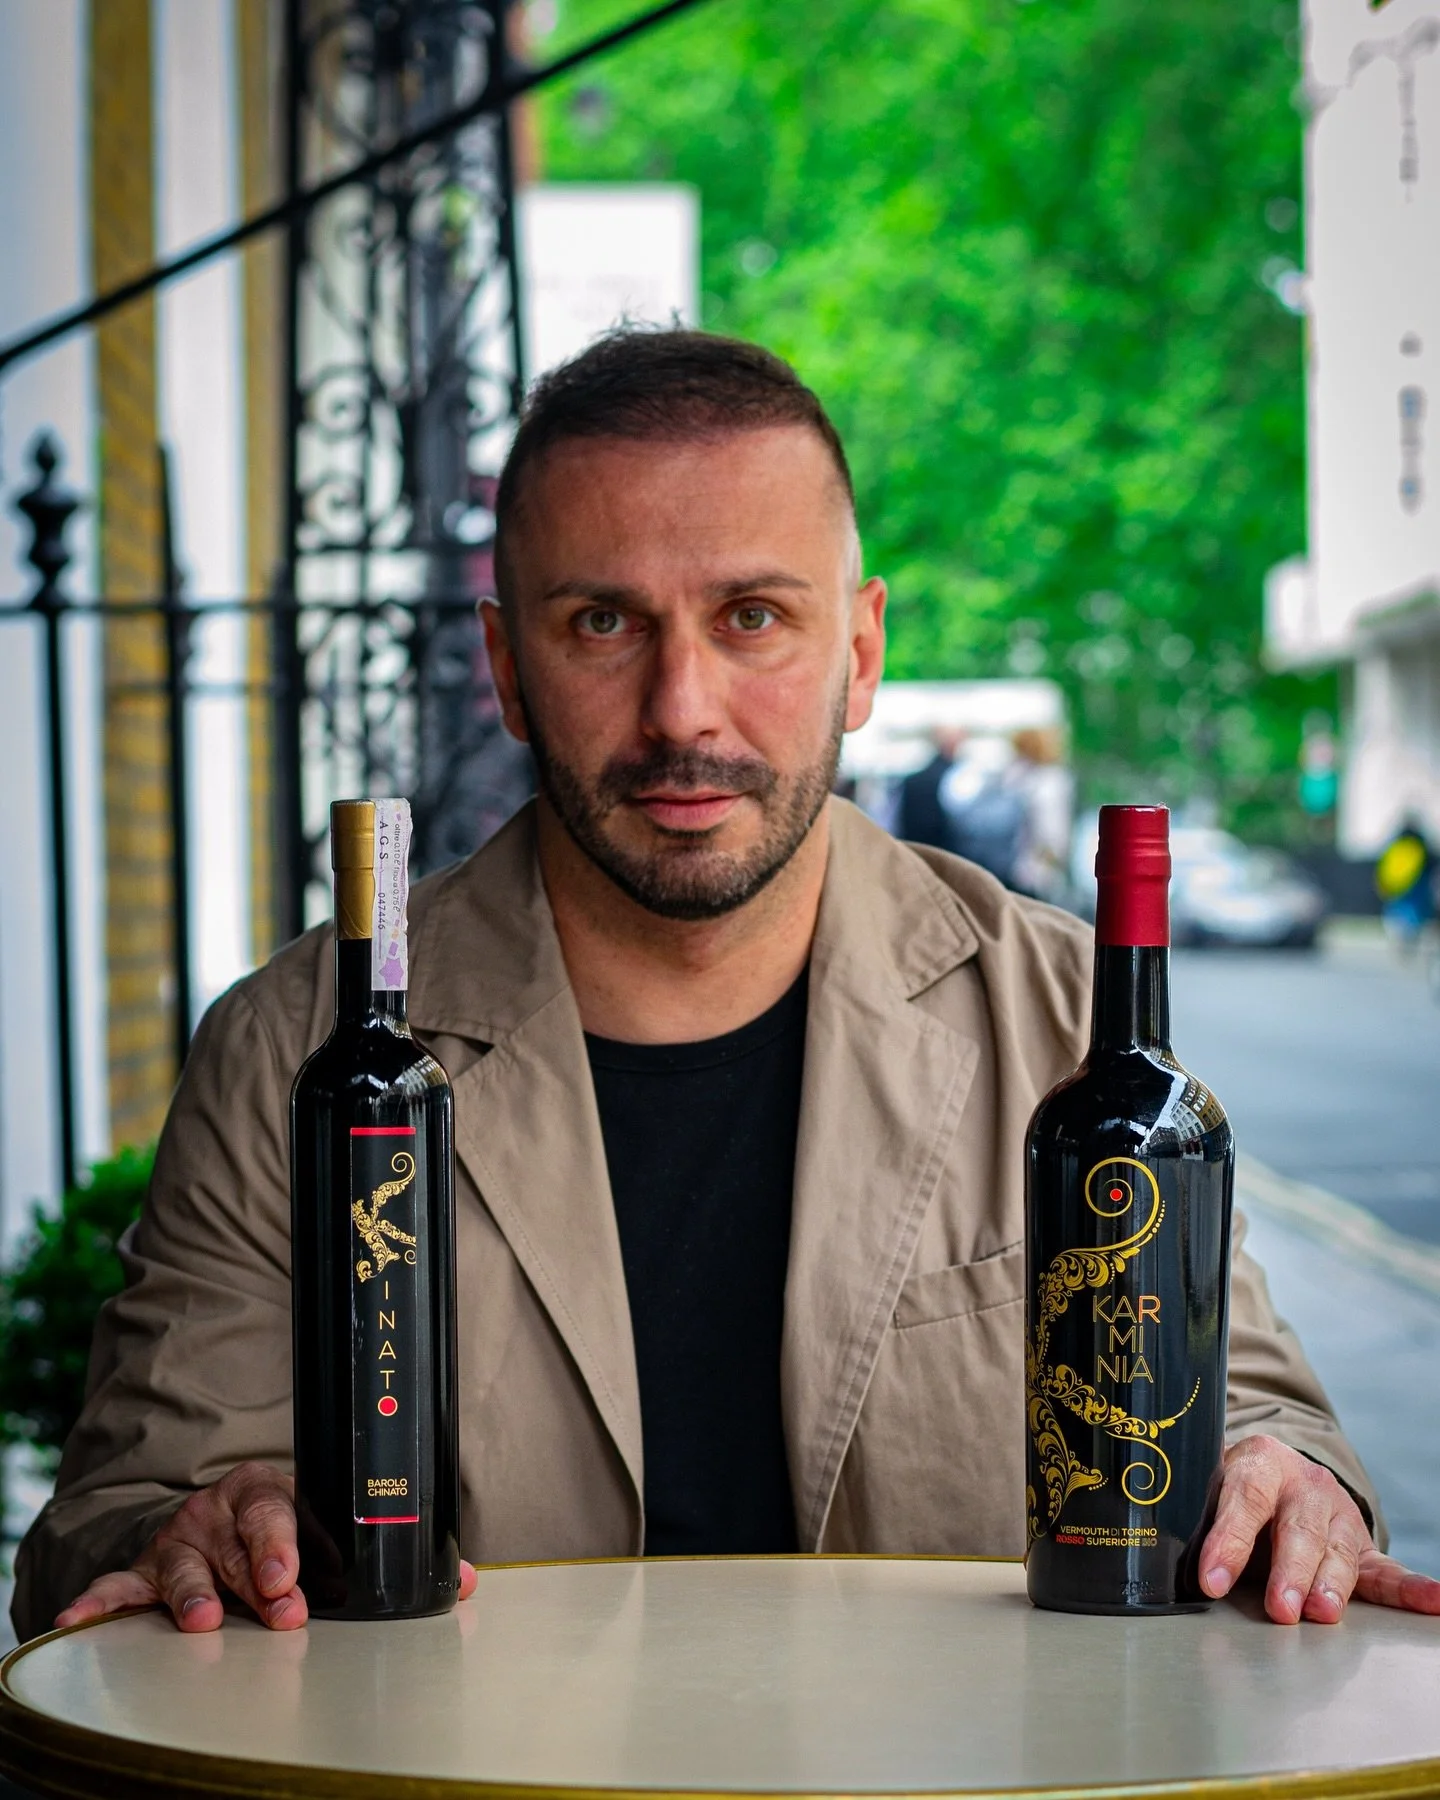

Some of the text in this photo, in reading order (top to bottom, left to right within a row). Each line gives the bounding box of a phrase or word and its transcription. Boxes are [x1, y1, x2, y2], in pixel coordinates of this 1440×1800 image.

[377, 892, 386, 930] 047446
[1092, 1295, 1161, 1323] KAR
[1109, 1325, 1144, 1353] MI
[1097, 1355, 1154, 1383] NIA
[367, 1478, 408, 1488] BAROLO
[367, 1487, 408, 1497] CHINATO
[1056, 1534, 1158, 1547] ROSSO SUPERIORE BIO
[1060, 1525, 1158, 1536] VERMOUTH DI TORINO
